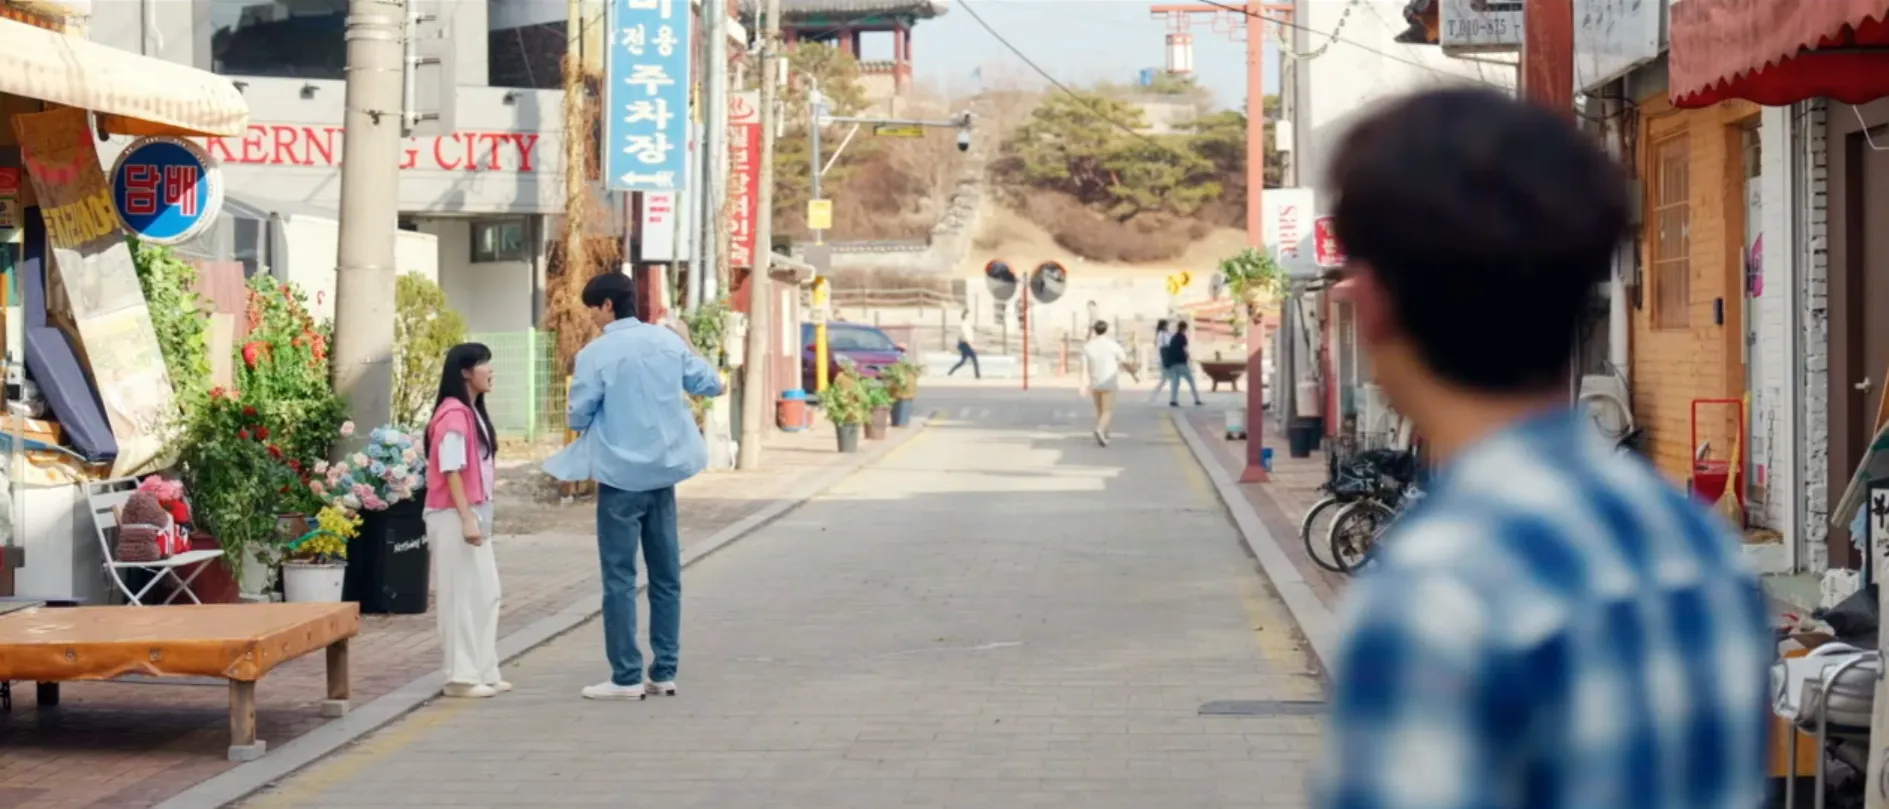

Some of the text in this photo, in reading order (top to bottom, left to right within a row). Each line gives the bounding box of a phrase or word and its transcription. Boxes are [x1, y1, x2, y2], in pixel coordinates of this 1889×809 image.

[622, 23, 678, 56] 전용
[623, 64, 675, 164] 주차장
[205, 125, 419, 169] KERNG
[433, 132, 539, 171] CITY
[124, 164, 199, 216] 담배
